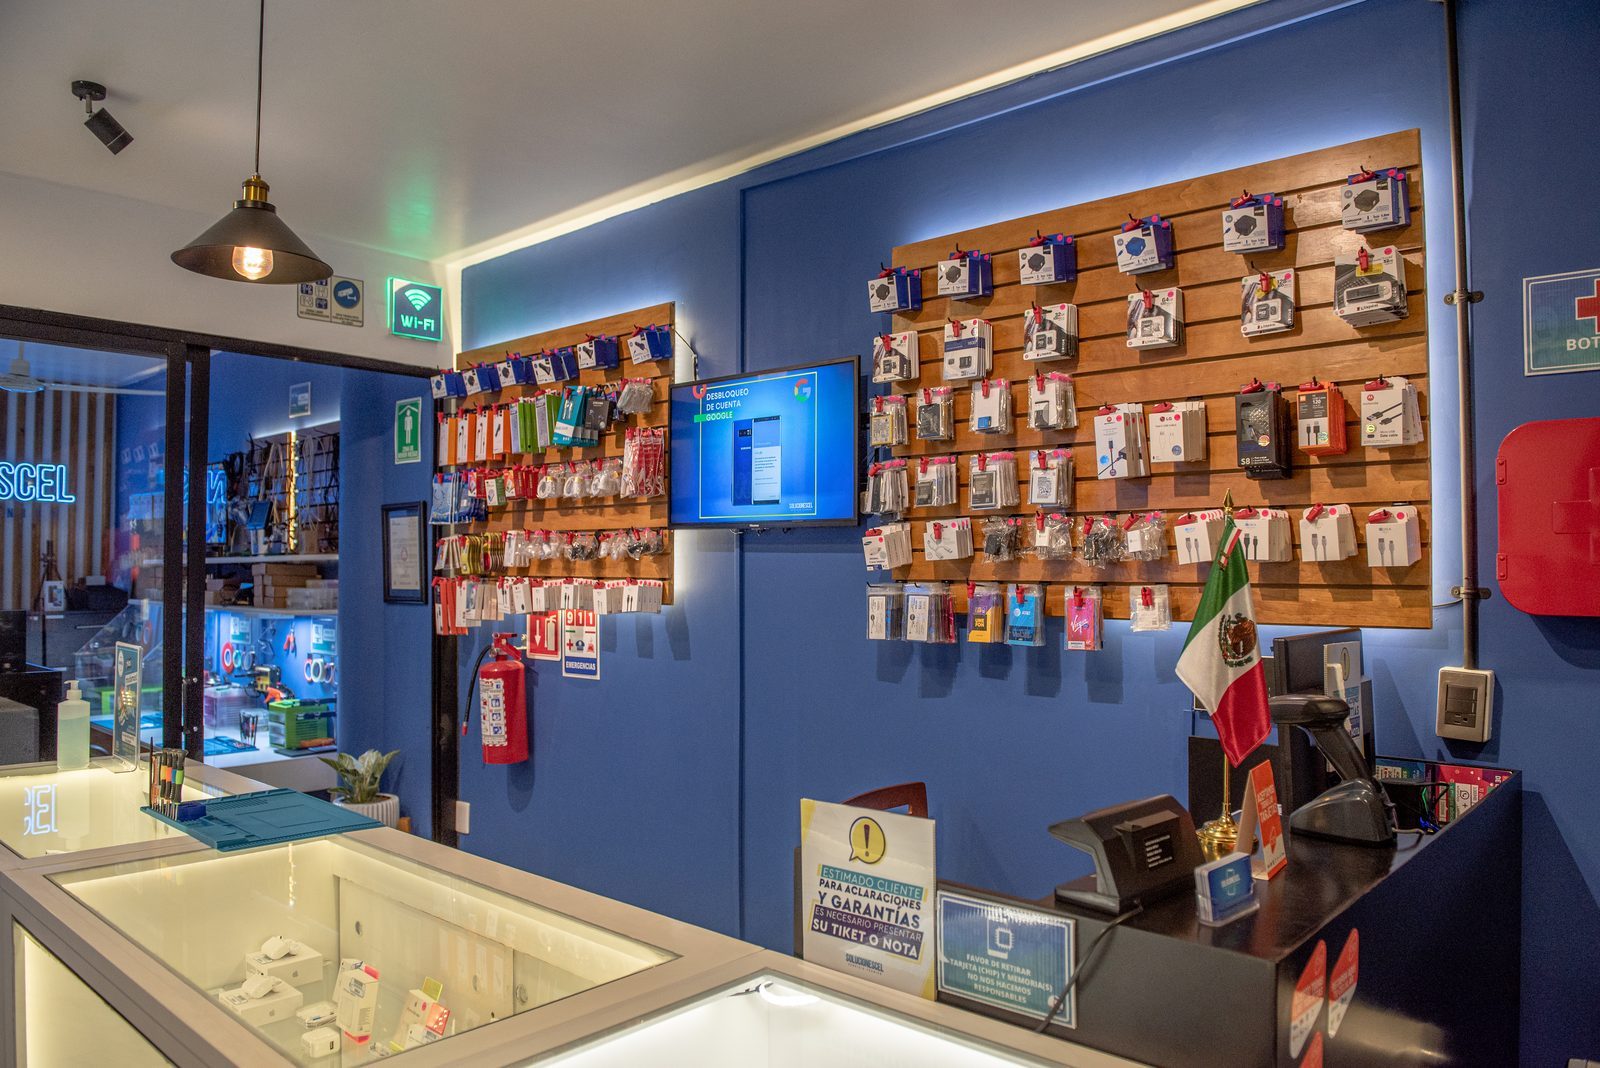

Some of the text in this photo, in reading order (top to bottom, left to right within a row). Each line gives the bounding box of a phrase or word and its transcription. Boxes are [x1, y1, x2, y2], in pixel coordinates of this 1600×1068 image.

[1566, 336, 1600, 351] BOT
[706, 388, 749, 400] DESBLOQUEO
[706, 400, 741, 411] DE CUENTA
[705, 411, 733, 421] GOOGLE
[565, 660, 596, 671] EMERGENCIAS
[819, 878, 921, 911] PARA ACLARACIONES
[823, 867, 921, 899] ESTIMADO CLIENTE
[818, 891, 920, 929] Y GARANTÍAS
[815, 906, 922, 942] ES NECESARIO PRESENTAR
[813, 918, 918, 958] SU TIKET O NOTA
[950, 958, 1053, 993] TARJETA (CHIP) Y MEMORIA(S)
[966, 953, 1032, 976] FAVOR DE RETIRAR
[967, 972, 1032, 996] NO NOS HACEMOS
[973, 983, 1027, 1004] RESPONSABLES
